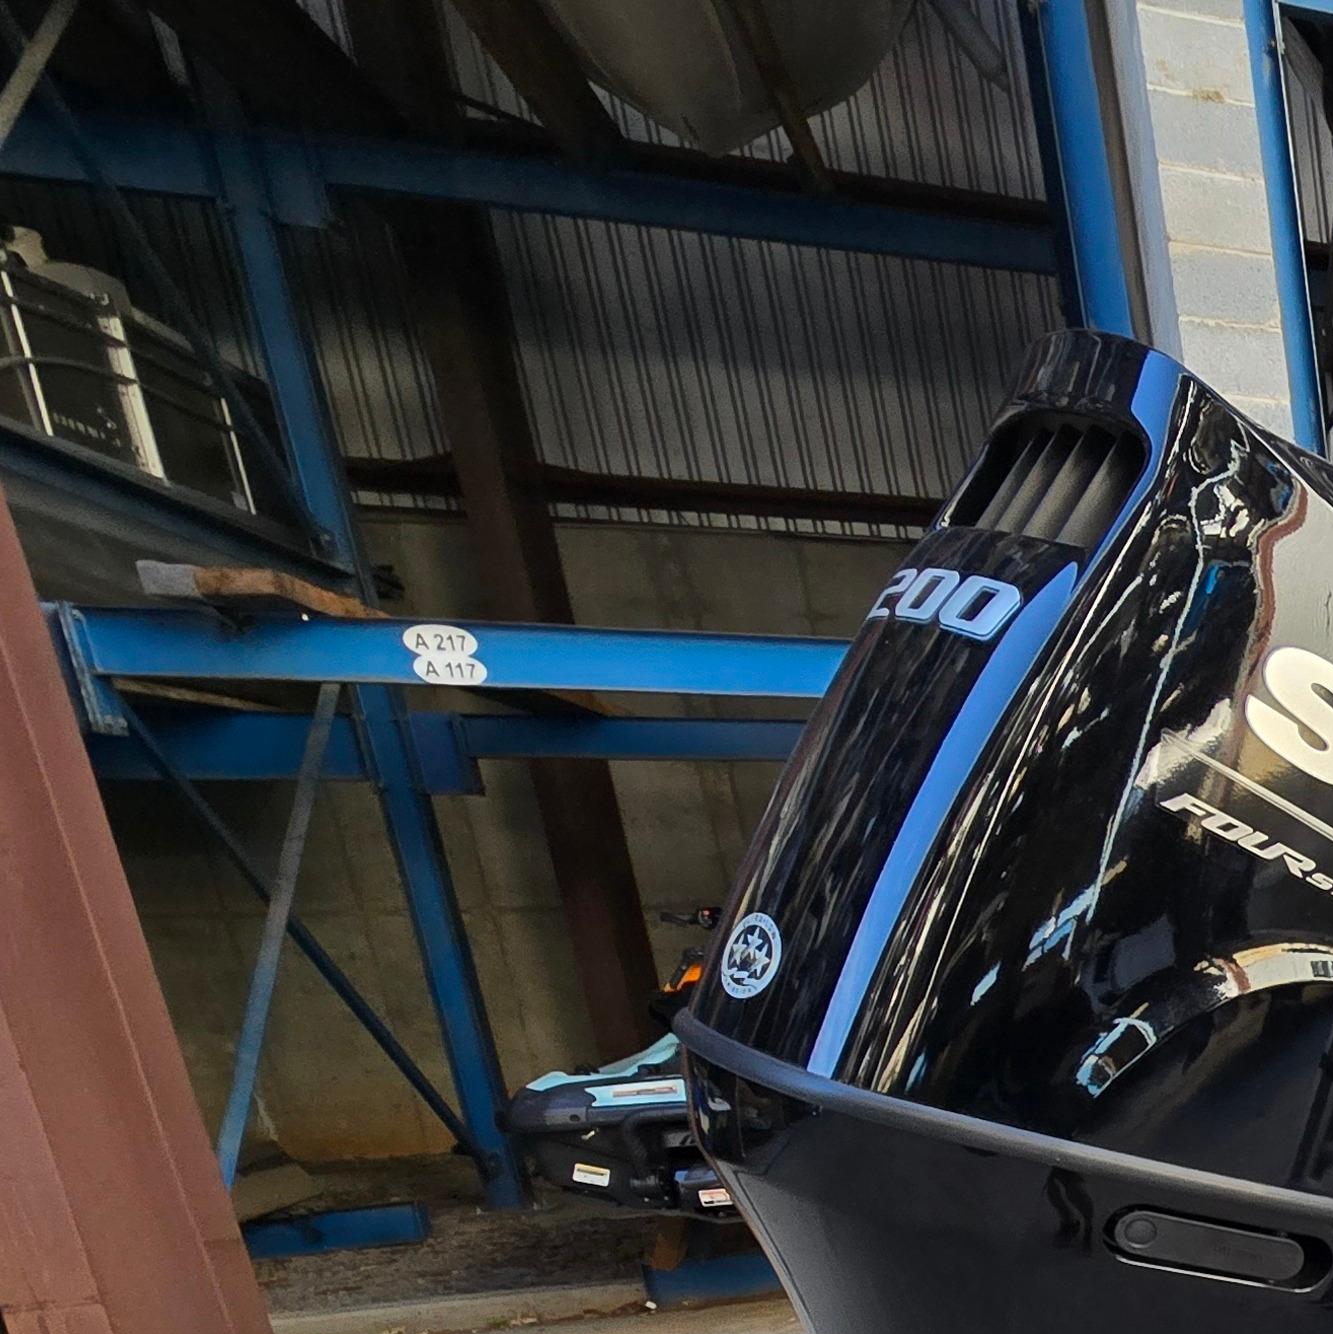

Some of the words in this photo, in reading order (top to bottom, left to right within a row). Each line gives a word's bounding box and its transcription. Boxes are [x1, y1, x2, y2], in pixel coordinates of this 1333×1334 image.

[866, 566, 1021, 641] 200
[415, 633, 430, 650] A
[433, 633, 466, 652] 217
[426, 661, 440, 677] A
[445, 661, 475, 679] 117
